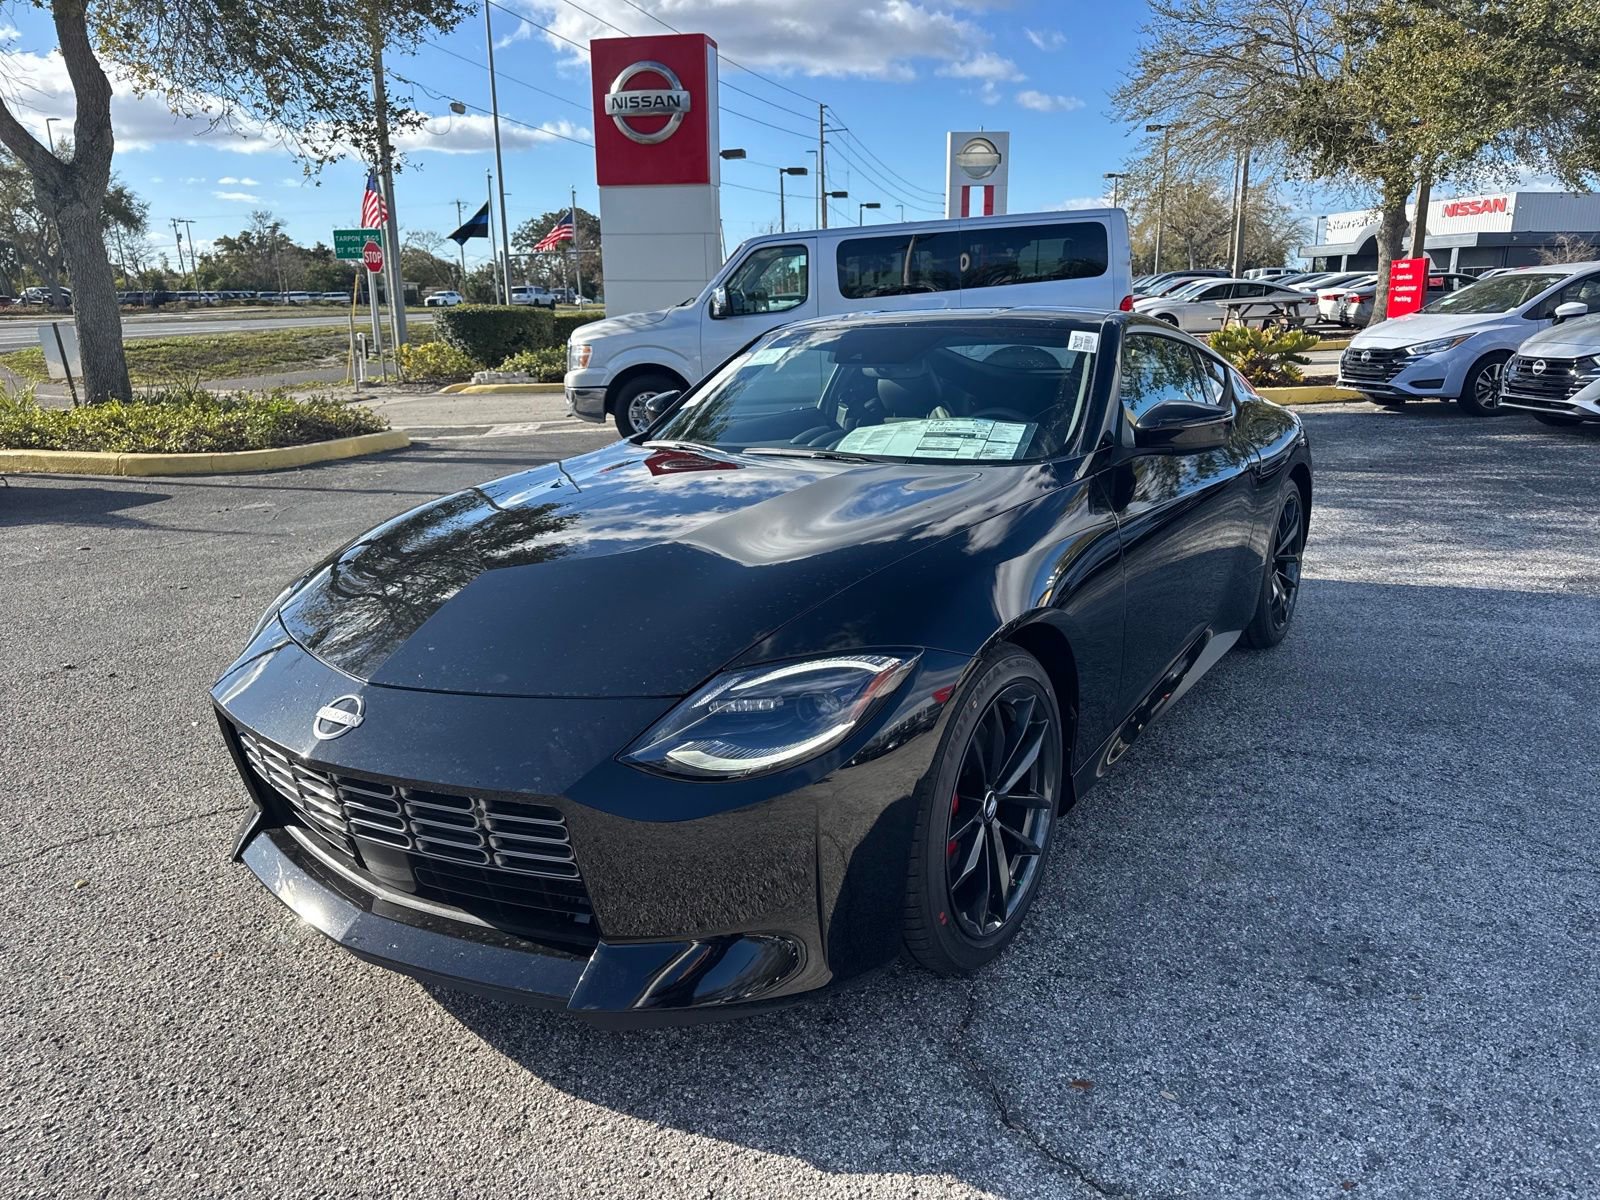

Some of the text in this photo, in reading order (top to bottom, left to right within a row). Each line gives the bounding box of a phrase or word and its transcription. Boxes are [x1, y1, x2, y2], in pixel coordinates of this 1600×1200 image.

[612, 95, 680, 109] NISSAN
[1442, 198, 1507, 217] NISSAN
[365, 251, 382, 263] STOP
